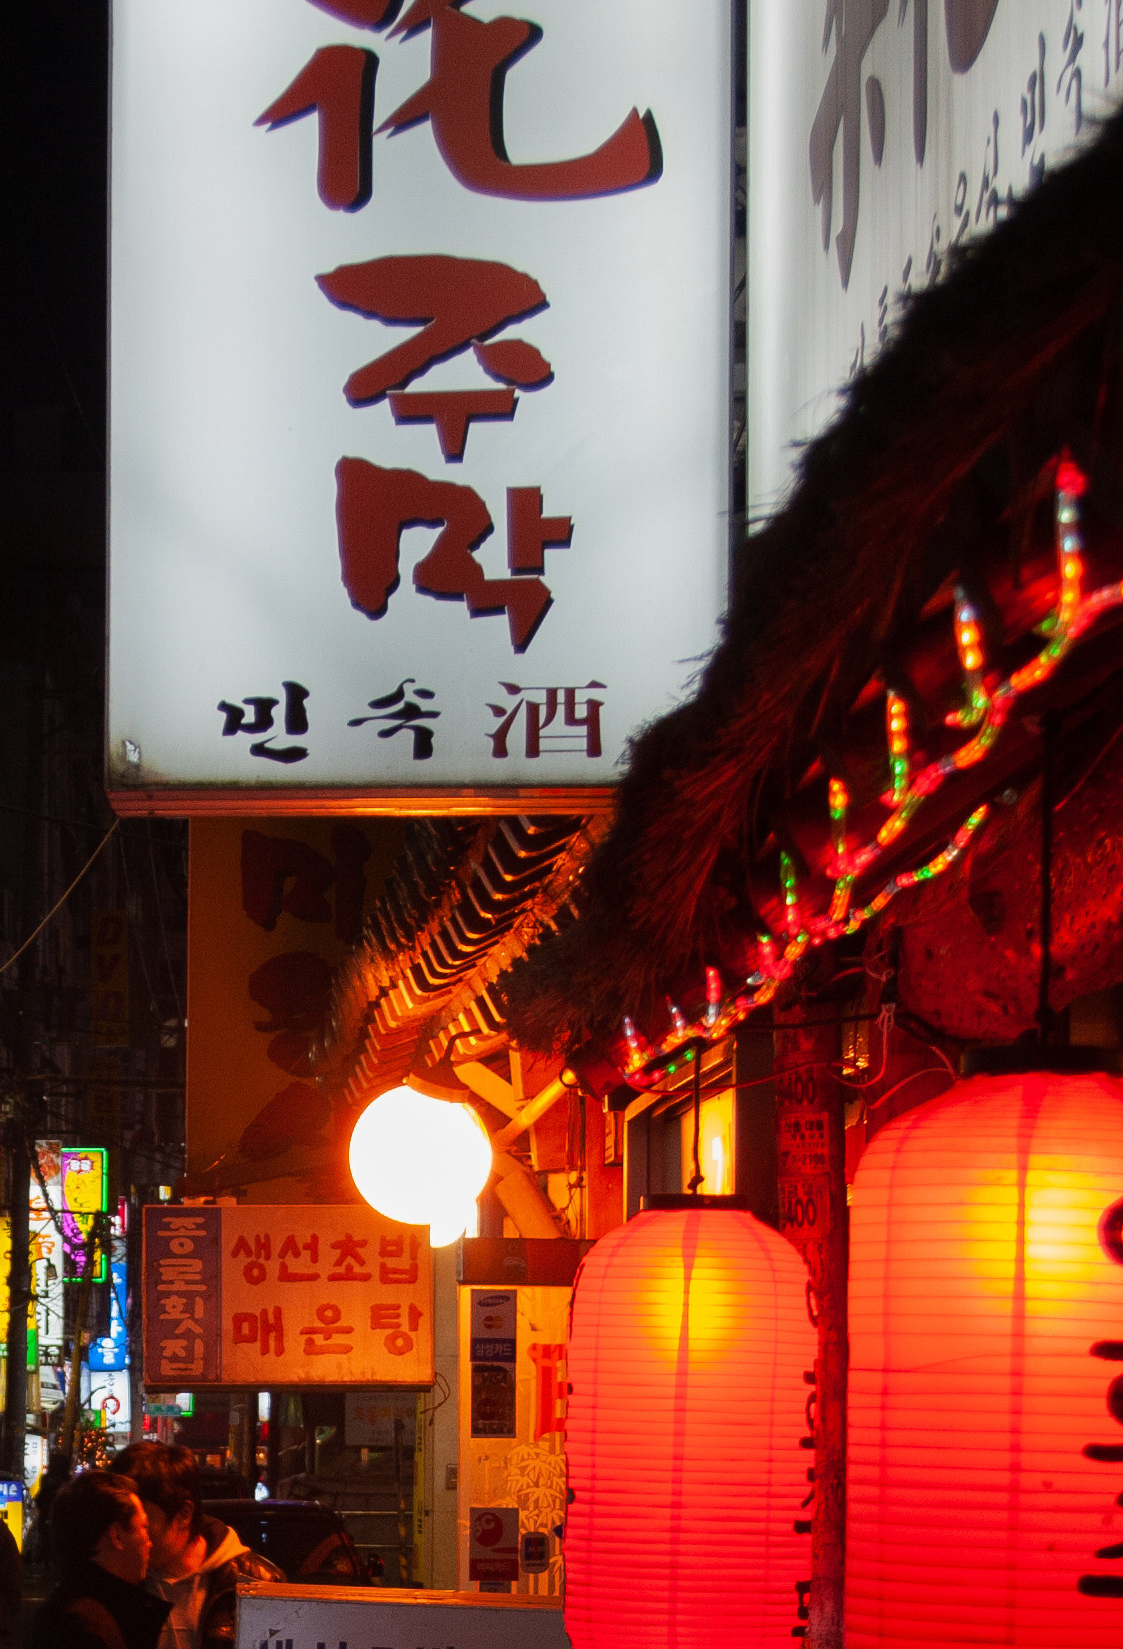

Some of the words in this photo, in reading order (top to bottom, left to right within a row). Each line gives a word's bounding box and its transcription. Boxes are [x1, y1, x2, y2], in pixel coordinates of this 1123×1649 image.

[230, 1232, 420, 1285] 생선초밥
[155, 1216, 208, 1378] 종로횟집
[231, 1302, 424, 1357] 매운탕
